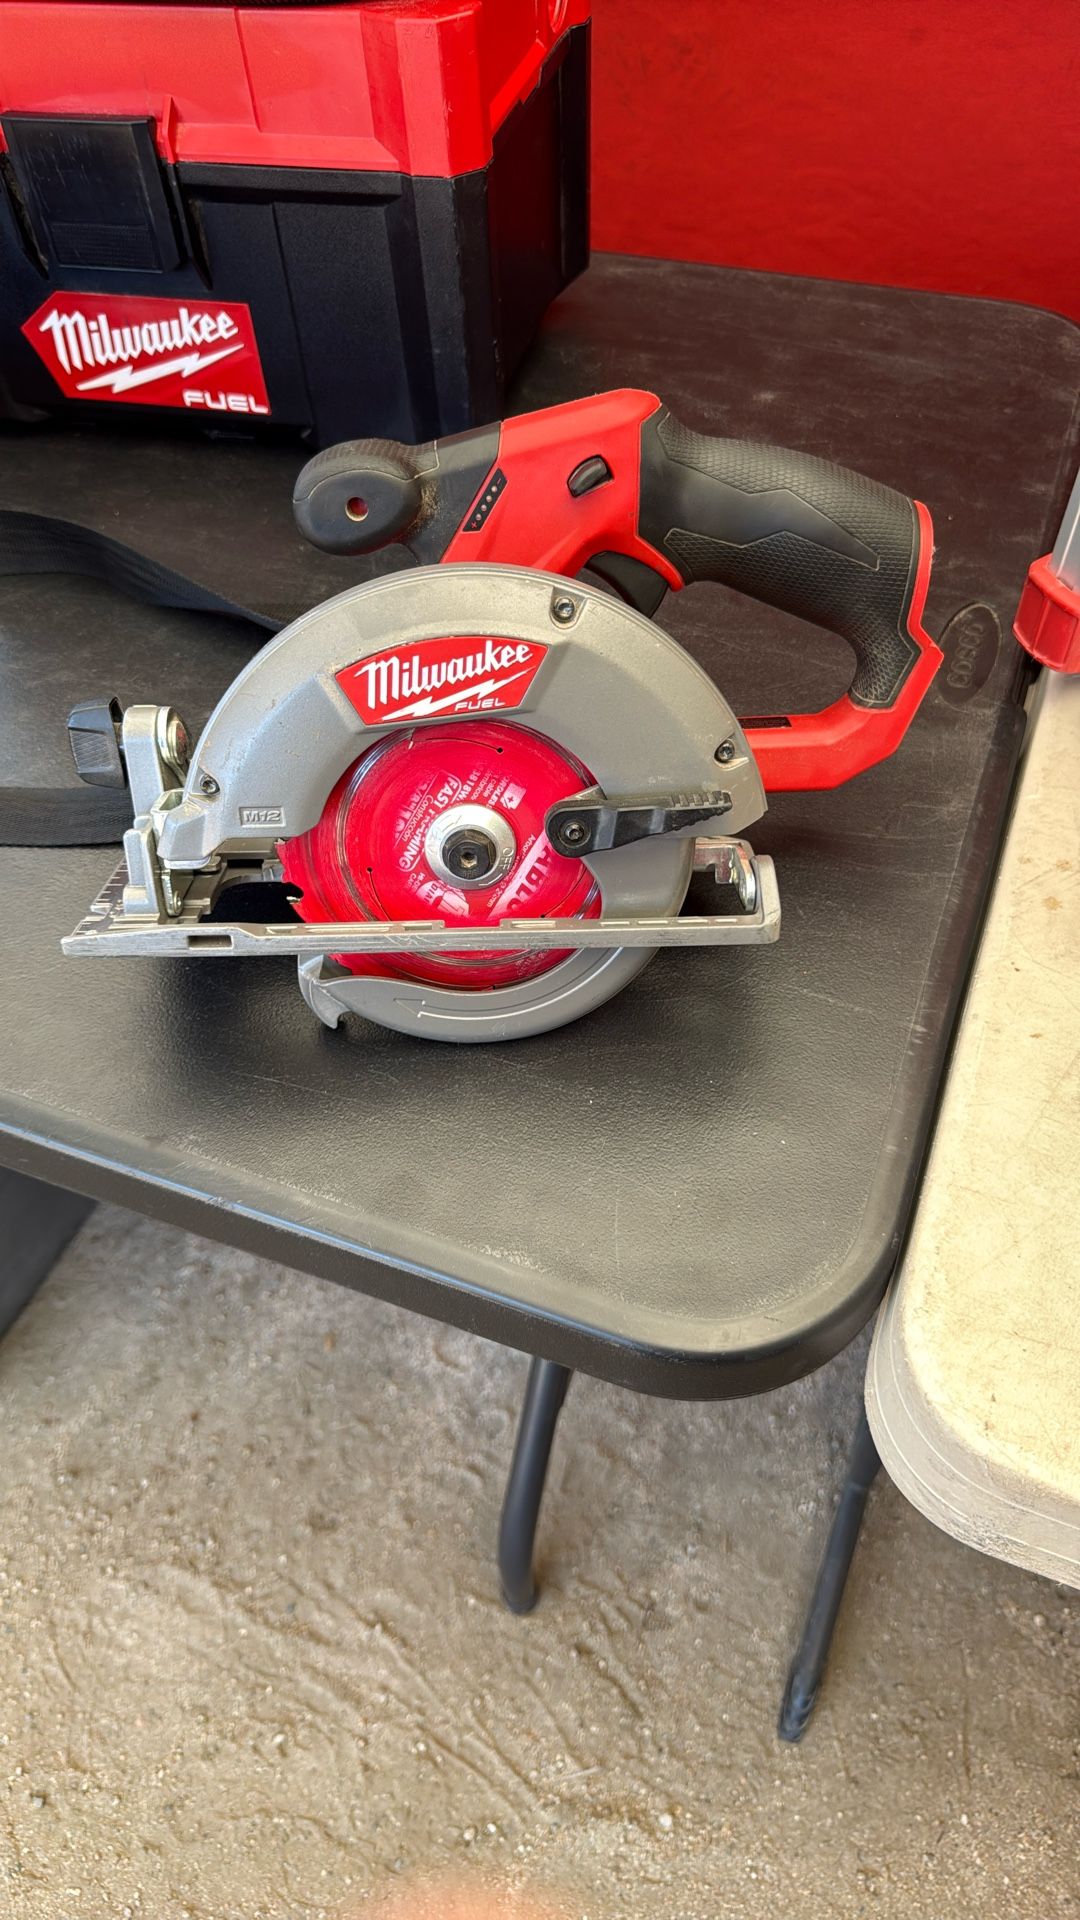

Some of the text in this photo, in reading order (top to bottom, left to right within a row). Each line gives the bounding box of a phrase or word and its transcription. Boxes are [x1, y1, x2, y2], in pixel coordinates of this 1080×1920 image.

[39, 307, 239, 375] Milwaukee
[183, 390, 268, 414] FUEL
[353, 640, 533, 709] Milwaukee
[454, 698, 506, 712] FUEL
[431, 775, 459, 809] FAST
[242, 809, 281, 823] M12
[497, 848, 514, 871] OFF
